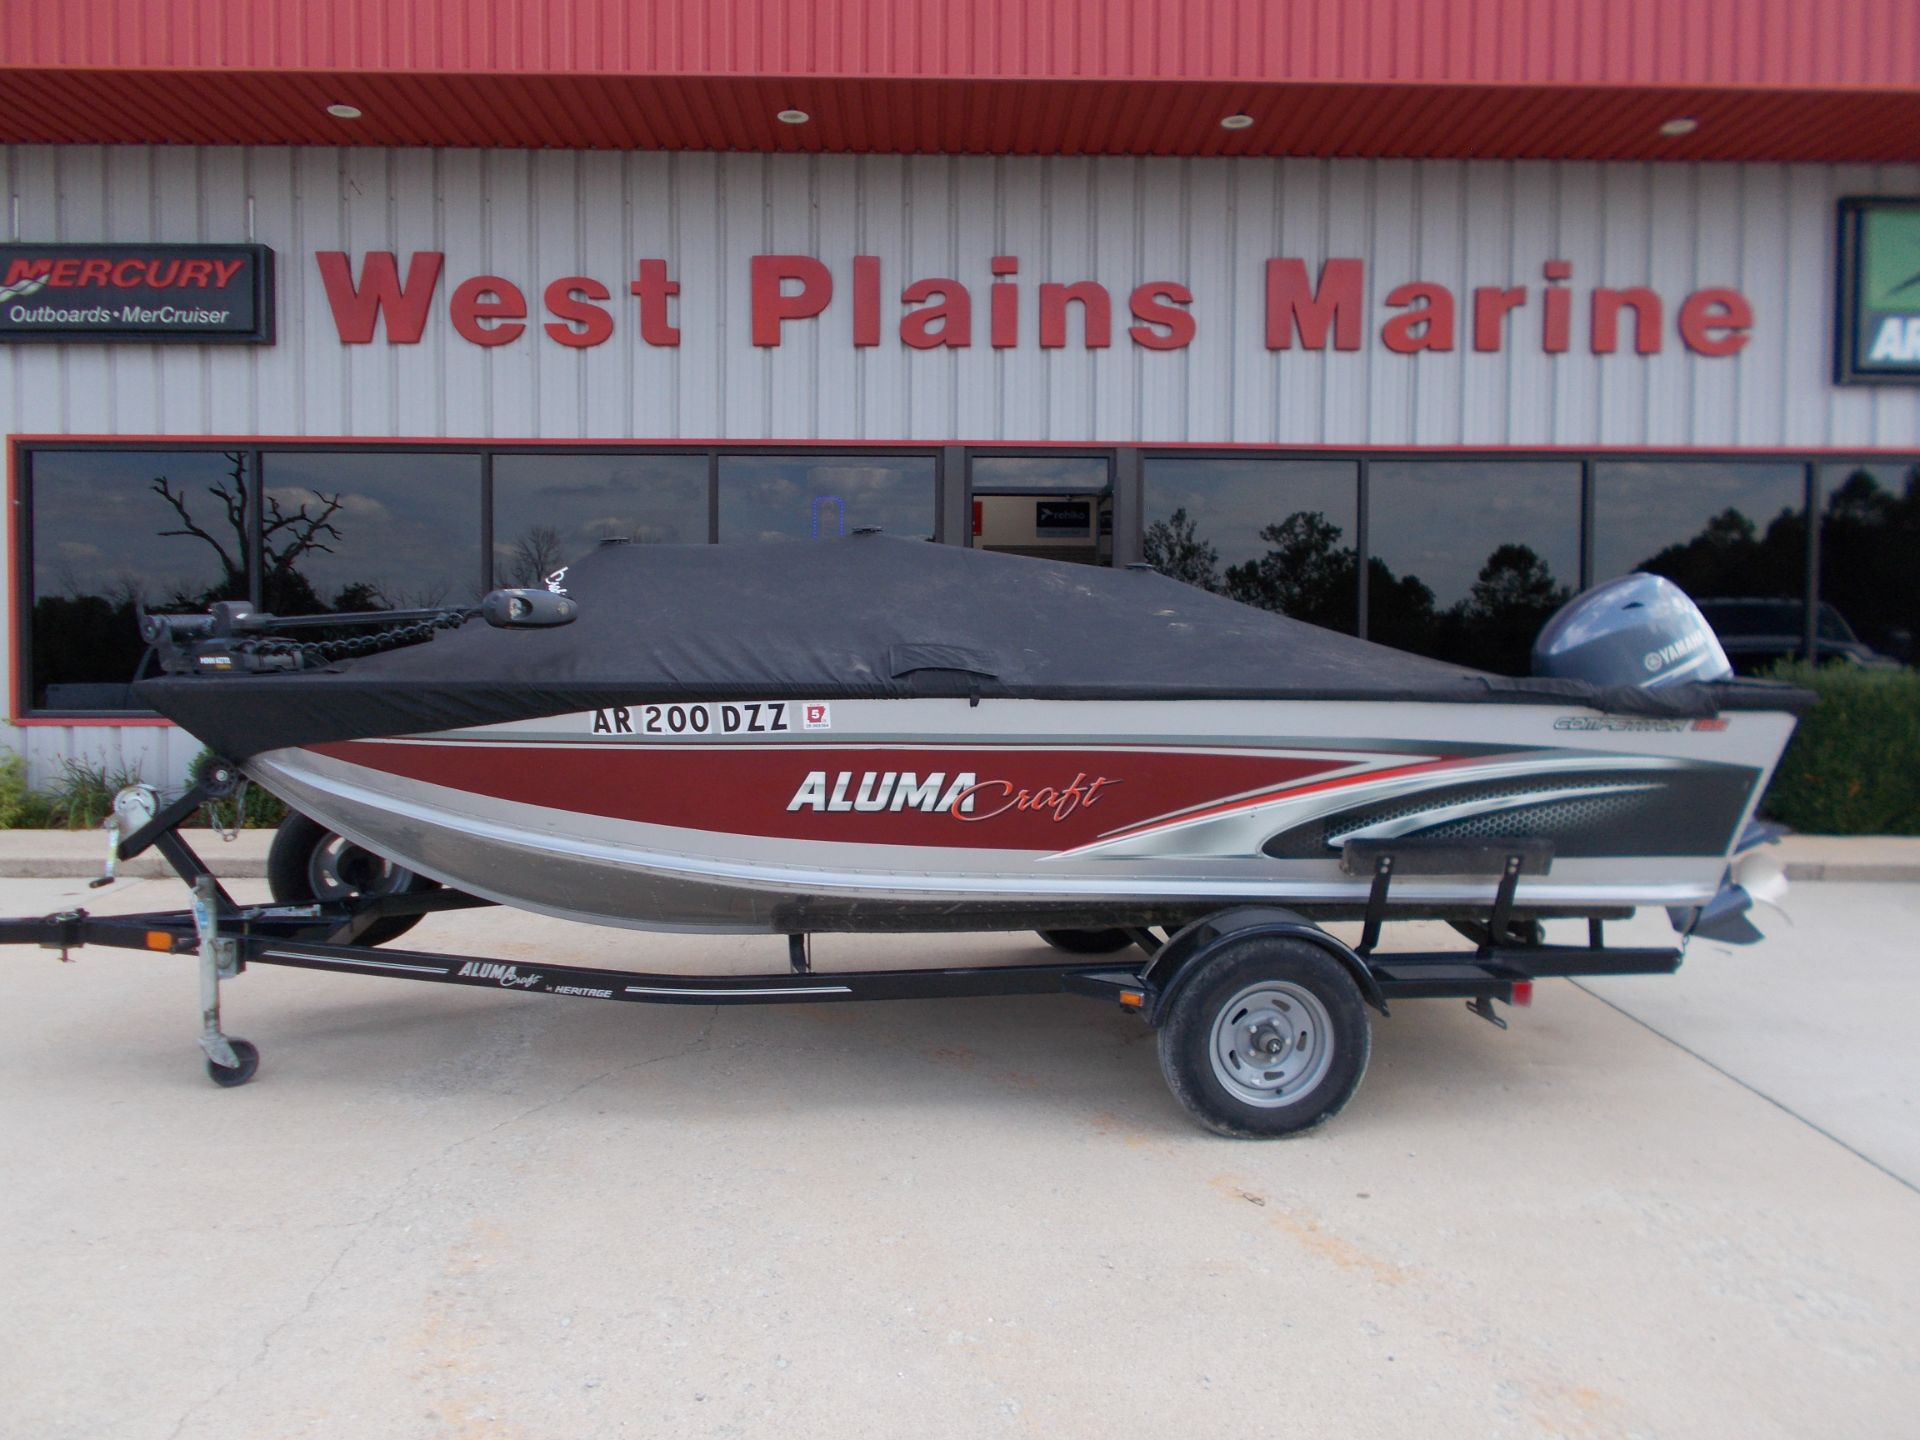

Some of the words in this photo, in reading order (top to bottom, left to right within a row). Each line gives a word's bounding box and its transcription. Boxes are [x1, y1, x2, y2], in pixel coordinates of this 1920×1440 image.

[4, 258, 244, 289] MERCURY
[315, 250, 680, 348] West
[750, 254, 1197, 351] Plains
[1264, 257, 1755, 357] Marine
[592, 706, 633, 733] AR
[645, 704, 710, 733] 200
[721, 703, 788, 732] DZZ
[811, 709, 820, 719] 5
[786, 771, 977, 812] ALUMA
[951, 772, 1124, 822] Craft
[554, 985, 614, 998] HERITAGE
